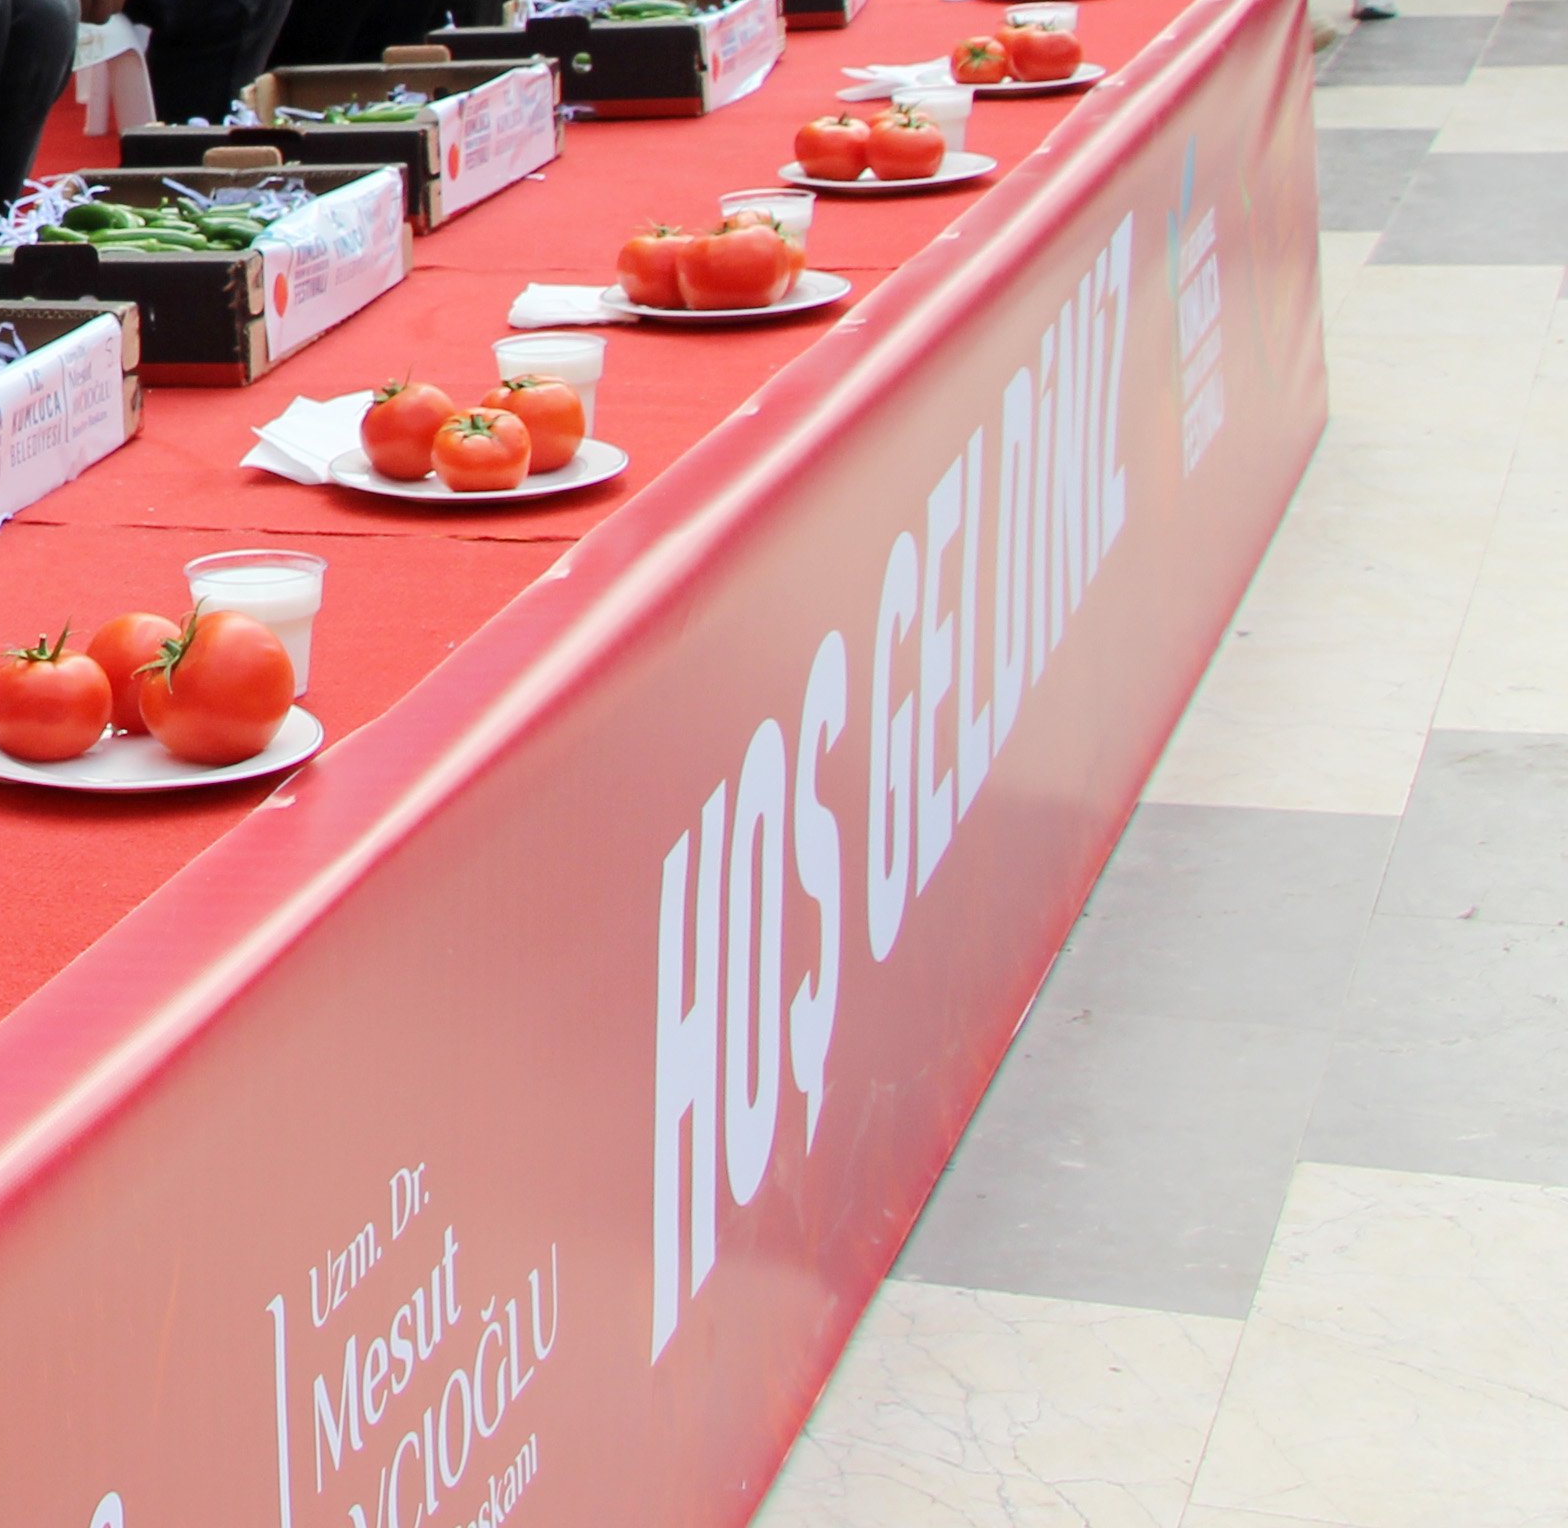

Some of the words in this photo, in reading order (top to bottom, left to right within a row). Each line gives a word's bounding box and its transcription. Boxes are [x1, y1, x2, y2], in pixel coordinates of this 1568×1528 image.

[650, 627, 848, 1368] HOŞ
[867, 209, 1134, 964] GELDİNİZ
[310, 1222, 382, 1328] Uzm.
[389, 1162, 430, 1240] Dr.
[313, 1224, 462, 1495] Mesut
